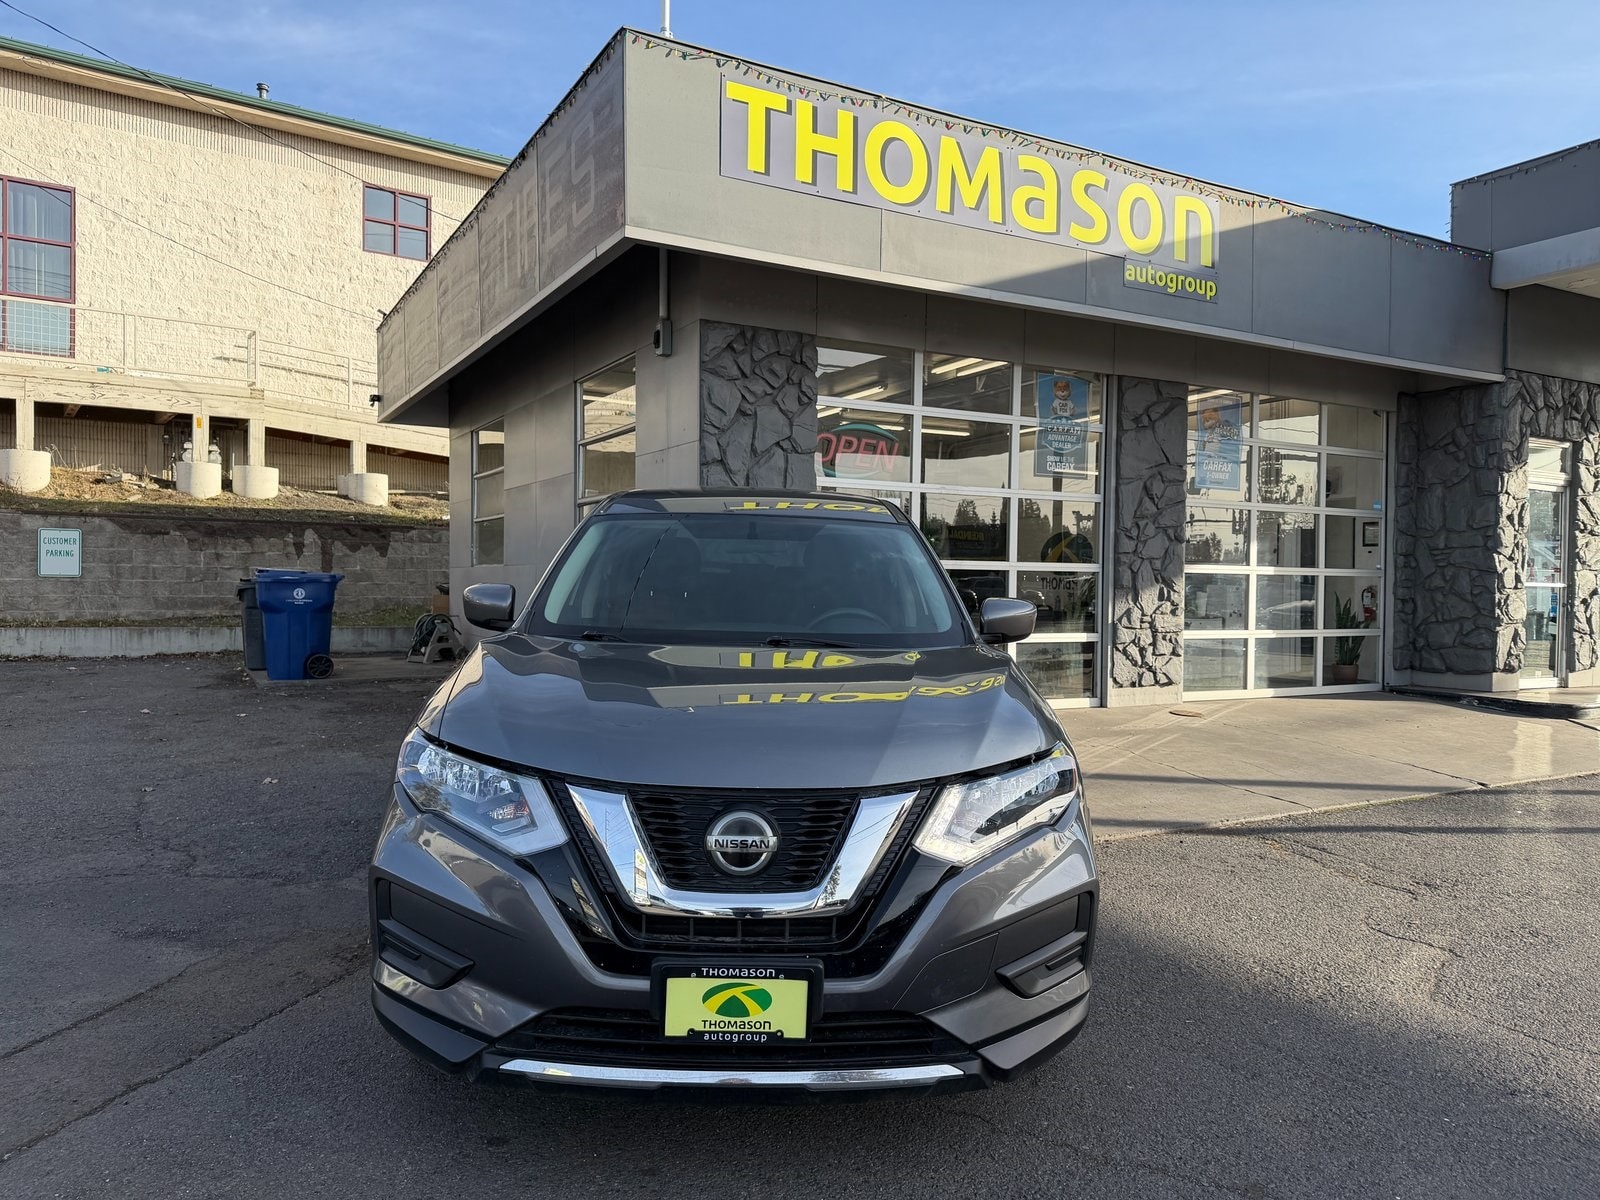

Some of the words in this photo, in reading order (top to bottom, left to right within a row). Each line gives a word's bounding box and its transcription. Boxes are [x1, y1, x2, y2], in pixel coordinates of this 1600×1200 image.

[726, 80, 1213, 267] THOMason
[1124, 263, 1218, 299] autogroup
[817, 432, 899, 473] OPEN
[1046, 461, 1075, 472] CARFAX
[1203, 460, 1233, 473] CARFAX
[43, 537, 77, 545] CUSTOMER
[713, 839, 770, 850] NISSAN
[701, 967, 776, 978] THOMason
[701, 1019, 772, 1031] THOMason
[703, 1032, 768, 1043] autogroup
